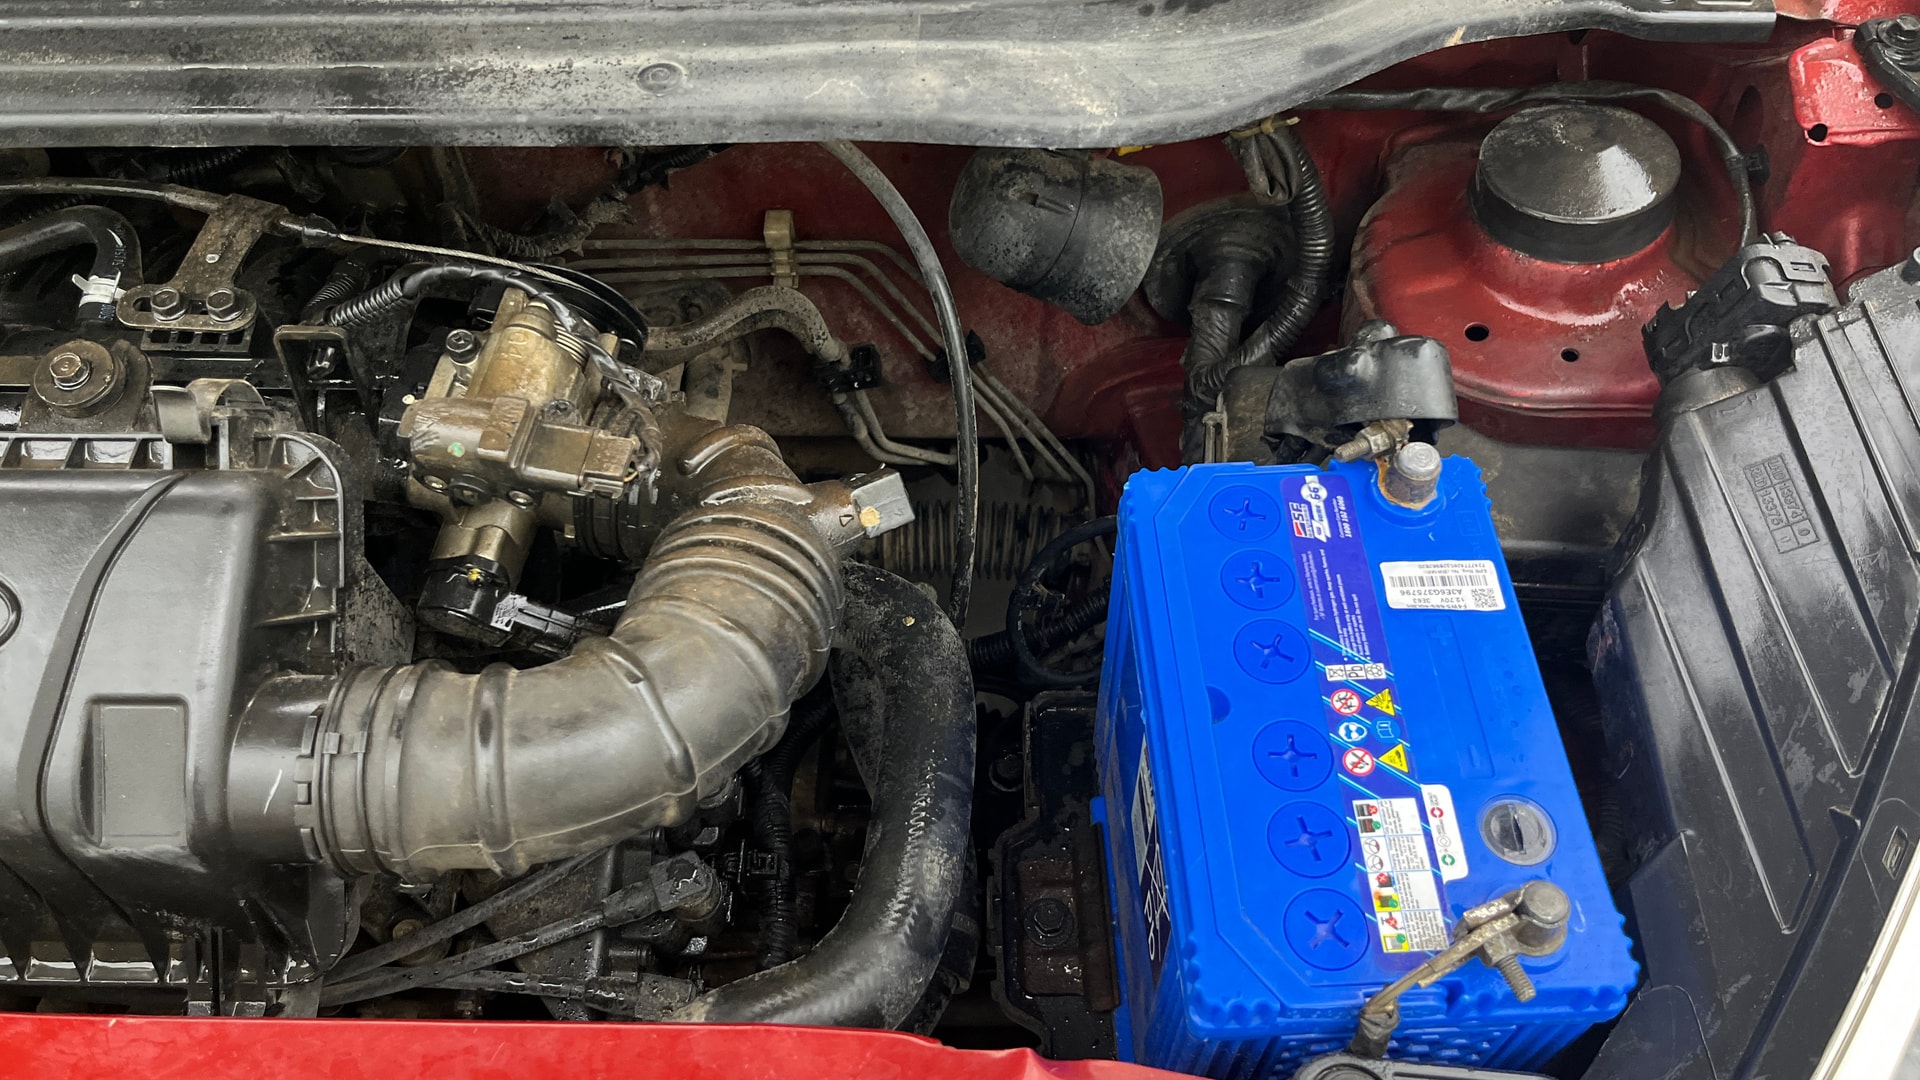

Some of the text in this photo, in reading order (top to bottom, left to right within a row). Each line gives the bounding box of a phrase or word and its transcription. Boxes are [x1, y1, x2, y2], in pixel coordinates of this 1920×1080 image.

[1308, 485, 1321, 500] 66
[1290, 503, 1305, 522] SF
[1348, 665, 1364, 678] Pb
